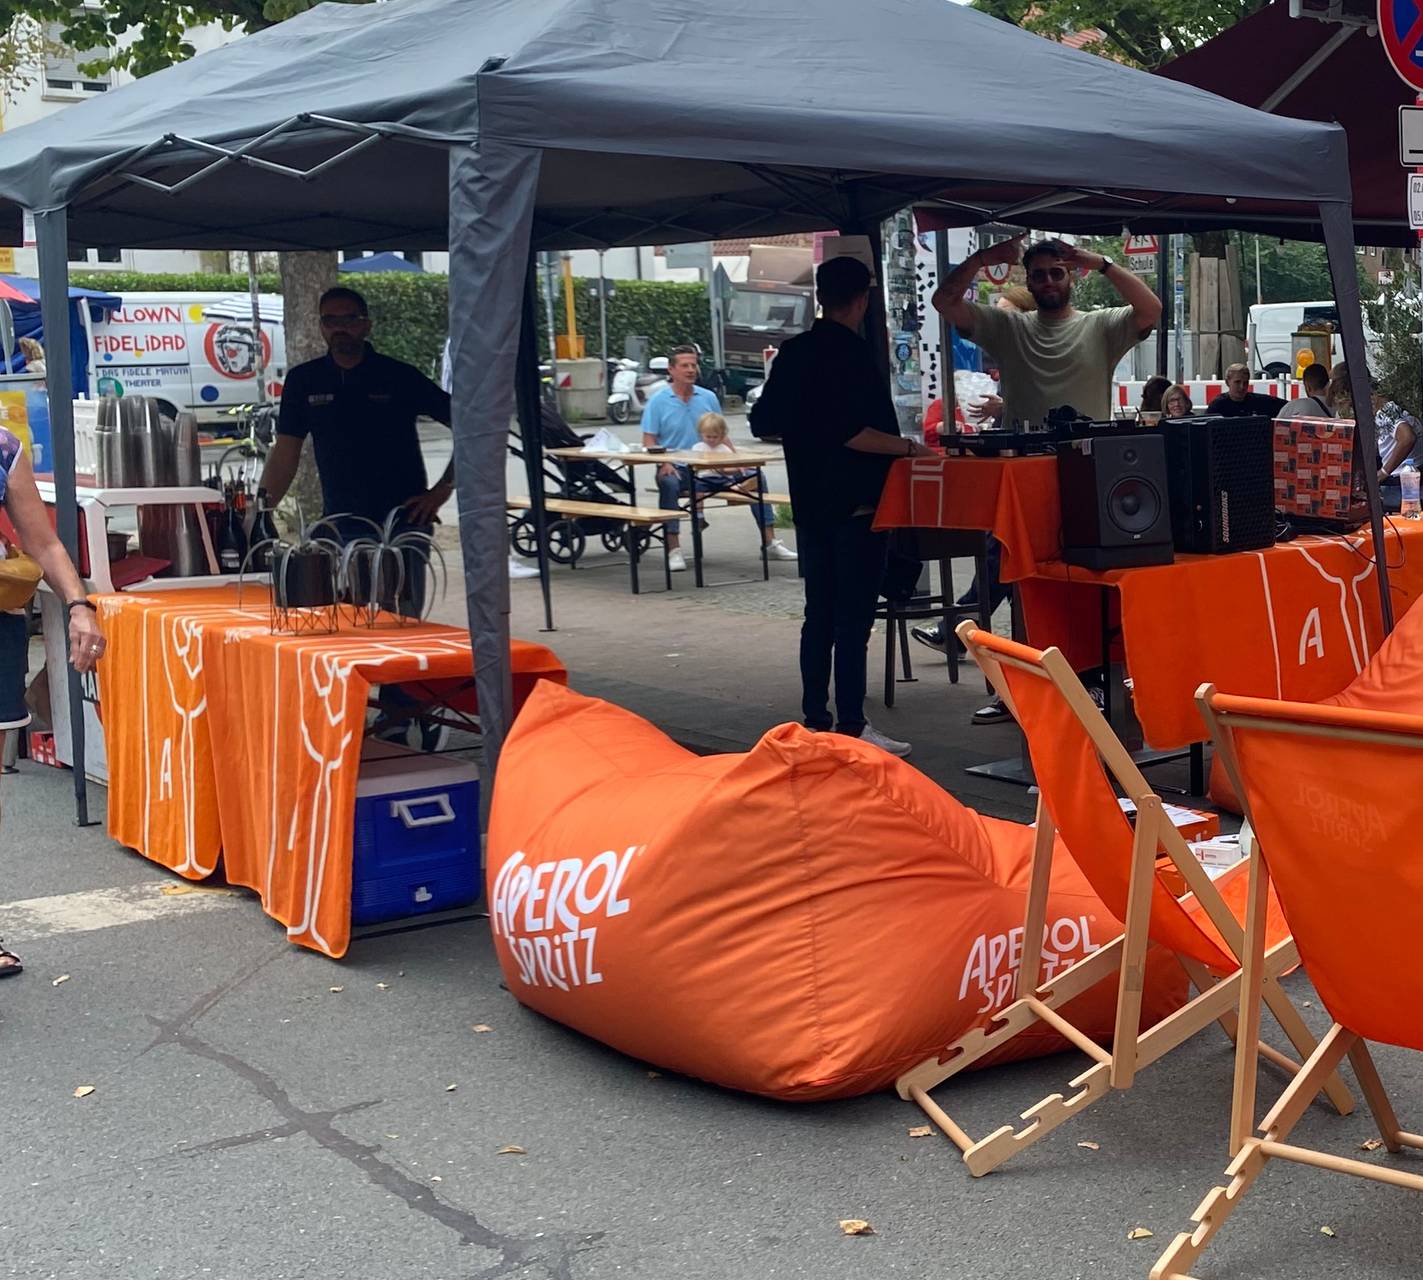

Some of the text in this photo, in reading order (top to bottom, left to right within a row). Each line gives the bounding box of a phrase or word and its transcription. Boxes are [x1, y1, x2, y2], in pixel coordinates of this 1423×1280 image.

[110, 306, 181, 323] CLOWN
[1299, 607, 1324, 666] A
[493, 847, 638, 938] APEROL
